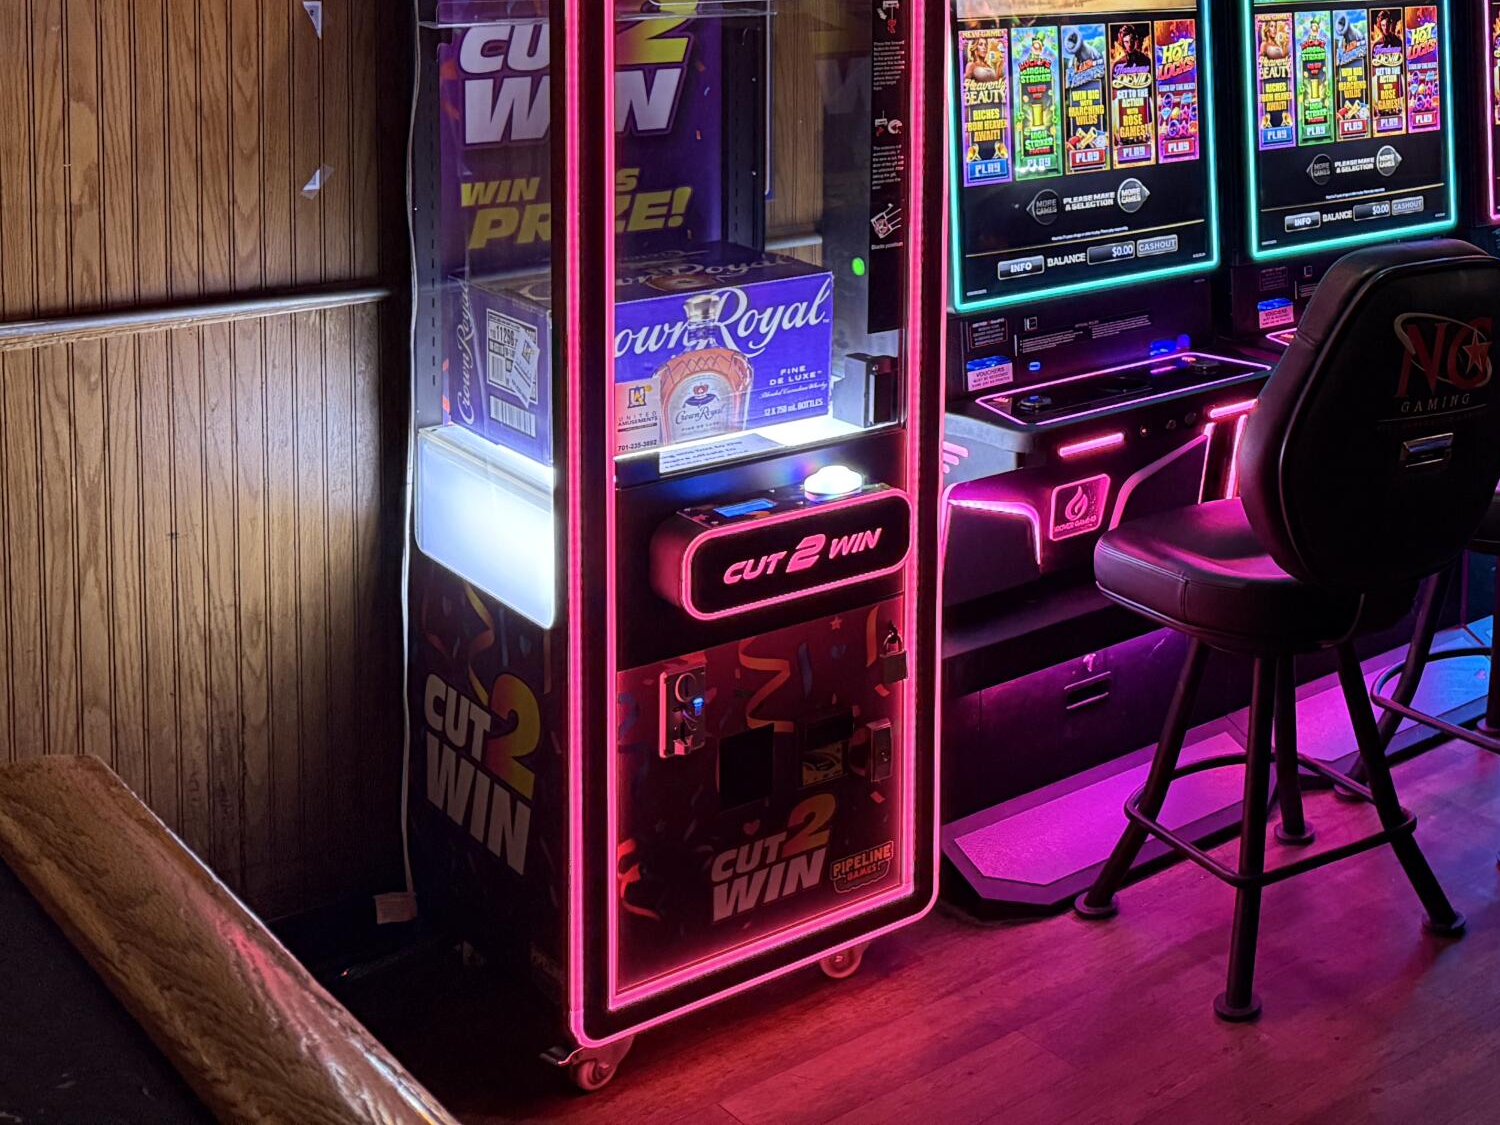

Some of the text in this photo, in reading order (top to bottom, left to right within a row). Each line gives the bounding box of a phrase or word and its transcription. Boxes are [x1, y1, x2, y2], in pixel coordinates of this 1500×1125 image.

[1161, 38, 1194, 65] HOT
[965, 89, 1007, 105] BEAUTY
[1167, 141, 1190, 153] PLAY
[1075, 151, 1100, 163] PLAY
[975, 162, 1001, 177] PLAY
[459, 177, 541, 207] WIN
[1063, 191, 1116, 205] PLEASE MAKE
[1120, 187, 1142, 198] MORE
[1120, 193, 1142, 204] GAMES
[1294, 216, 1312, 227] INFO
[1322, 210, 1353, 223] BALANCE
[1392, 199, 1423, 211] CASHOUT
[1010, 238, 1177, 273] INFO BALANCE $0.00 CASHOUT
[711, 277, 831, 358] Royal
[769, 372, 816, 386] DE LUXE
[780, 365, 807, 376] FINE
[797, 400, 824, 412] BOTTLES
[1400, 392, 1472, 413] GAMING
[617, 411, 657, 423] UNITED
[617, 415, 658, 427] AMUSEMENTS
[675, 408, 700, 426] Crown
[723, 527, 882, 585] CUT 2 WIN
[423, 672, 542, 800] CUT 2
[425, 730, 532, 876] WIN
[781, 793, 838, 856] 2
[710, 831, 788, 883] CUT
[832, 843, 892, 877] PIPELINE
[712, 847, 828, 923] WIN
